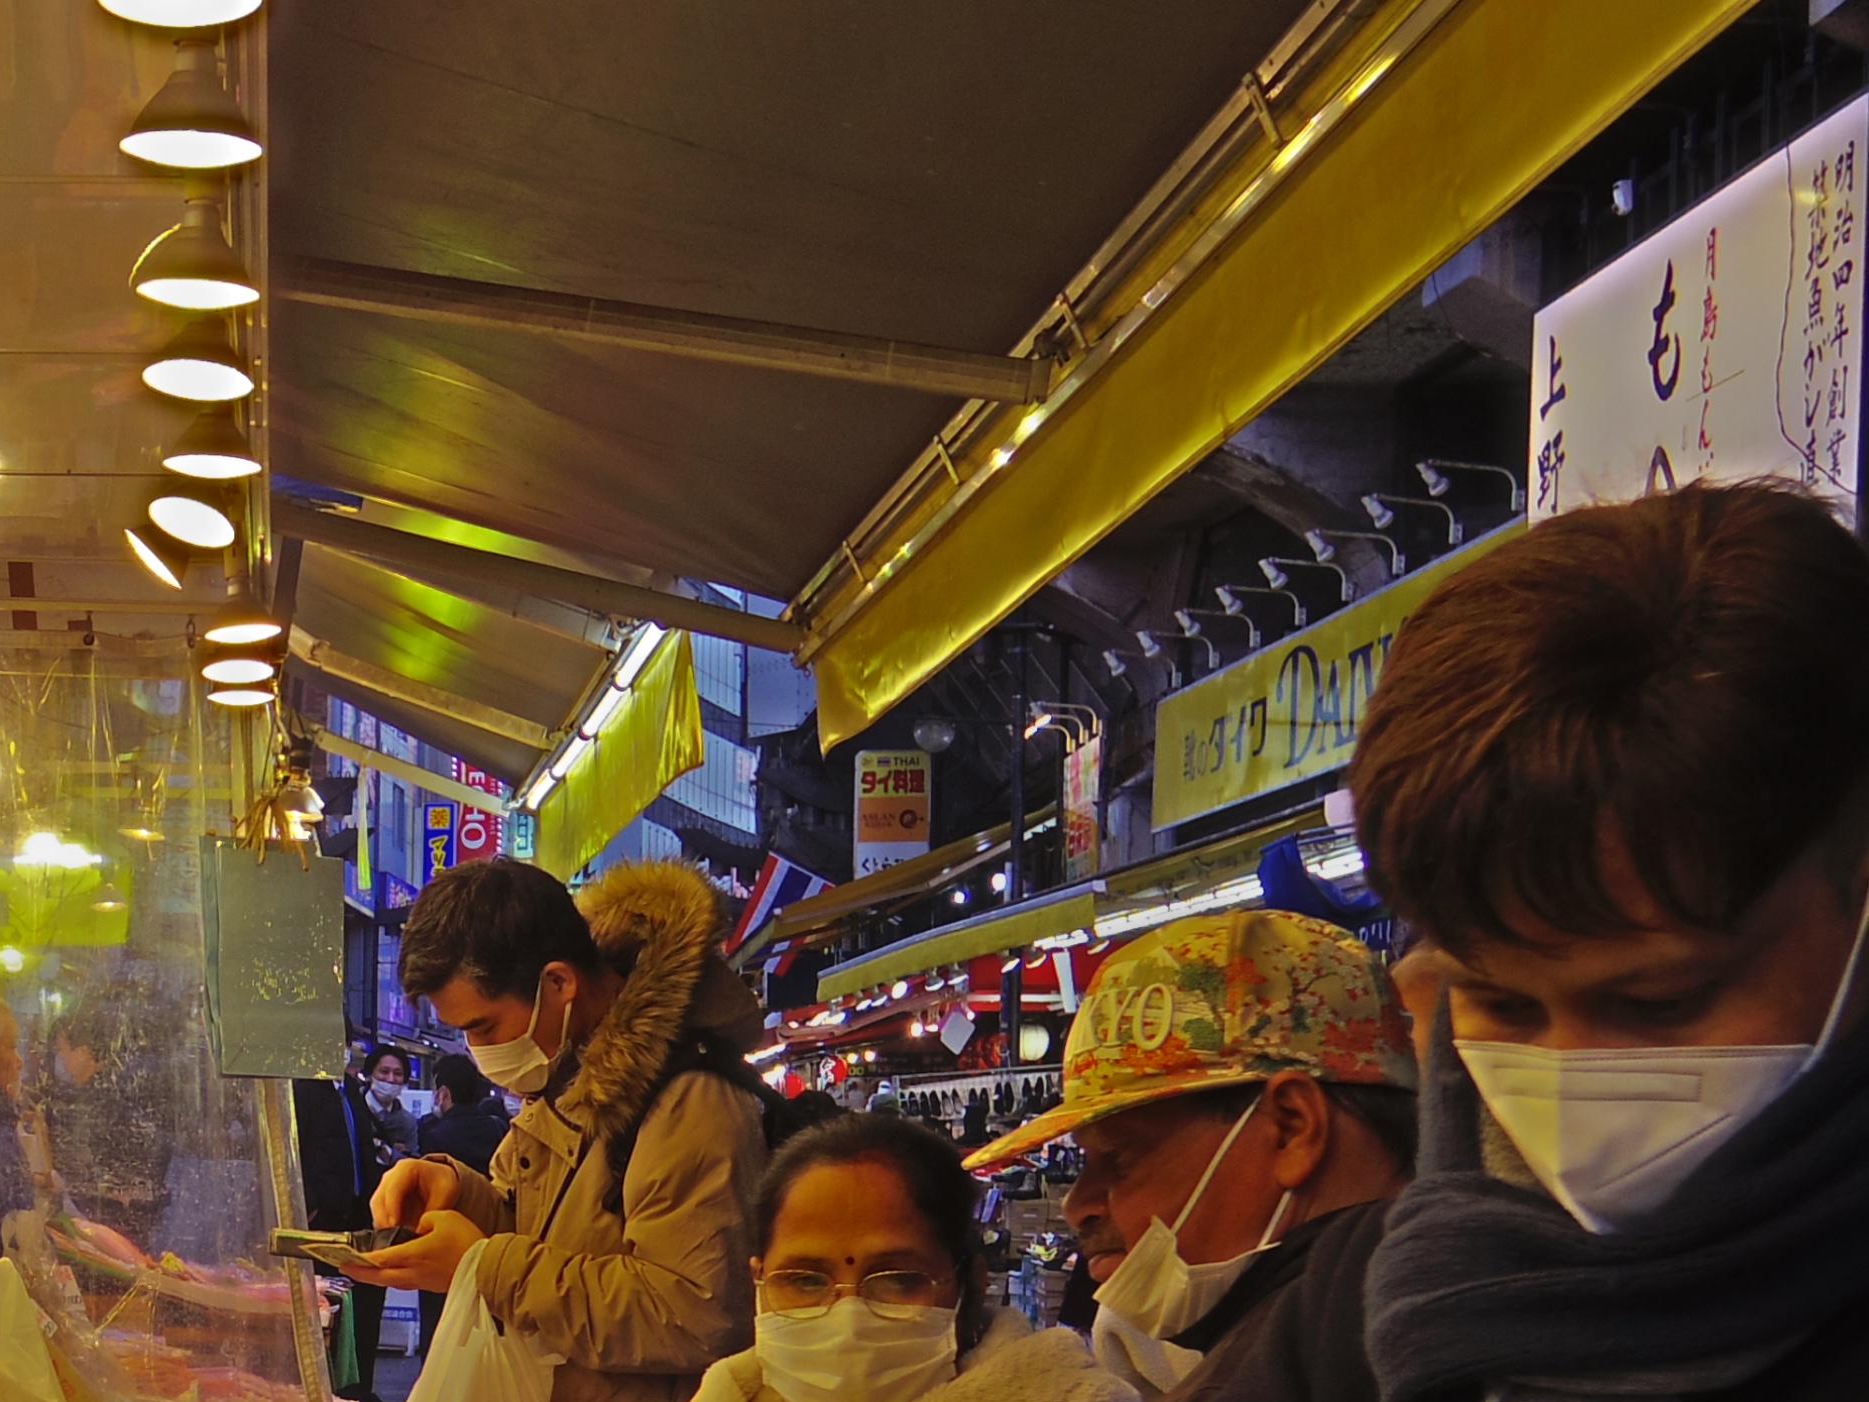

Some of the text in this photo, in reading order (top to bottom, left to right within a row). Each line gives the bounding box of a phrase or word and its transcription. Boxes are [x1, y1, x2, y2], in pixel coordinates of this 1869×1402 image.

[1697, 228, 1719, 472] 月島もん
[893, 757, 920, 766] THAI
[861, 769, 925, 793] タイ料理
